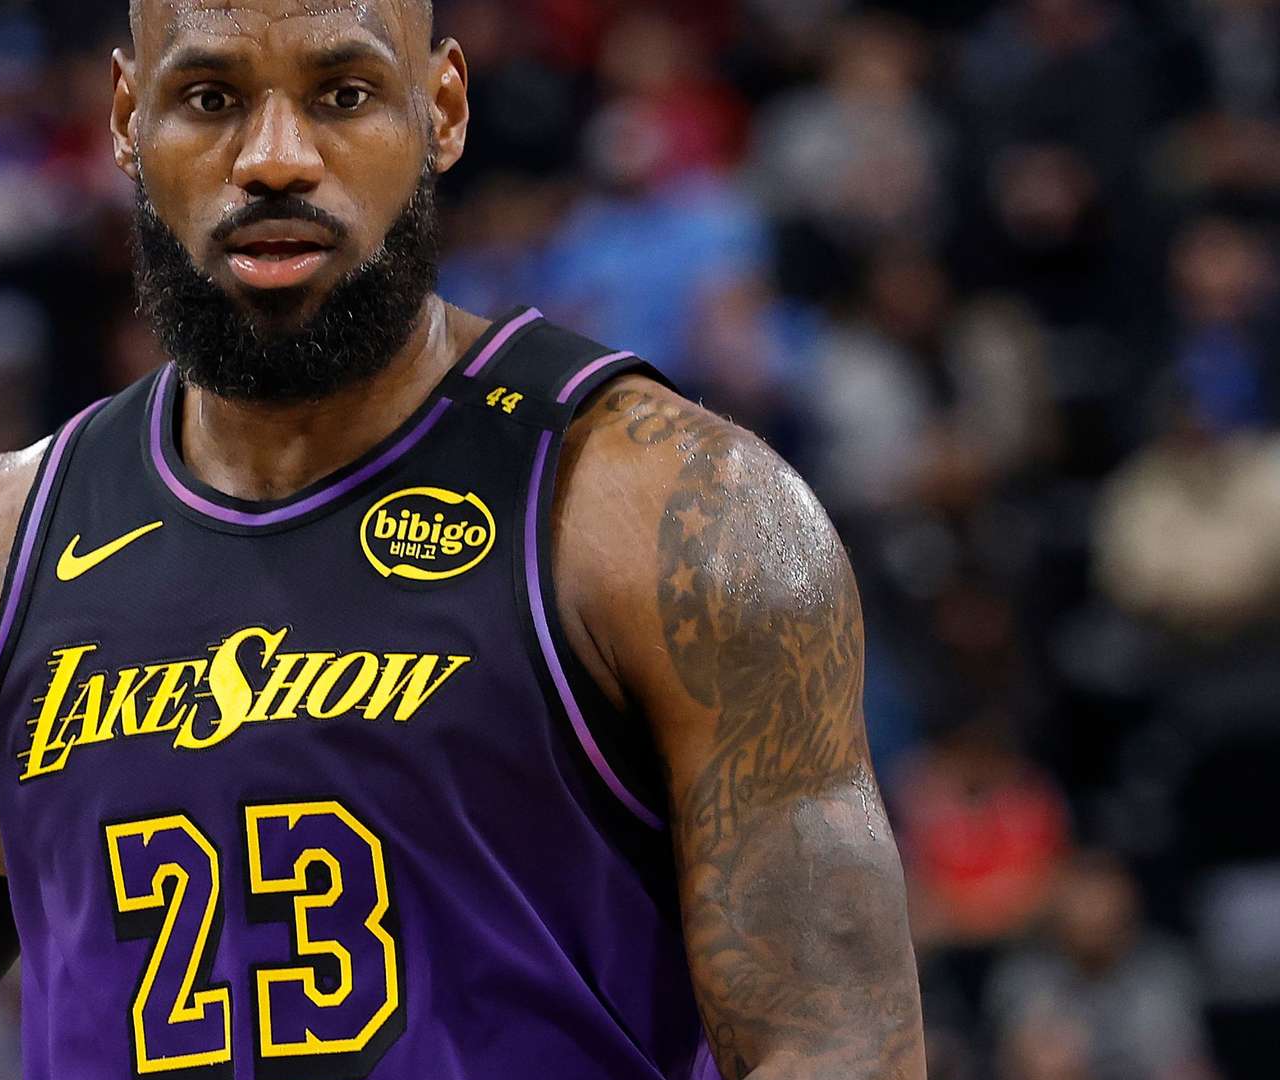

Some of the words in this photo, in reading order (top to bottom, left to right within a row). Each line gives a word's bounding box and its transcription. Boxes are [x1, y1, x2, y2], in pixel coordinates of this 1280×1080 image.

[486, 387, 523, 414] 44
[374, 509, 487, 555] bibigo
[389, 541, 437, 560] 비비고
[104, 799, 403, 1078] 23
